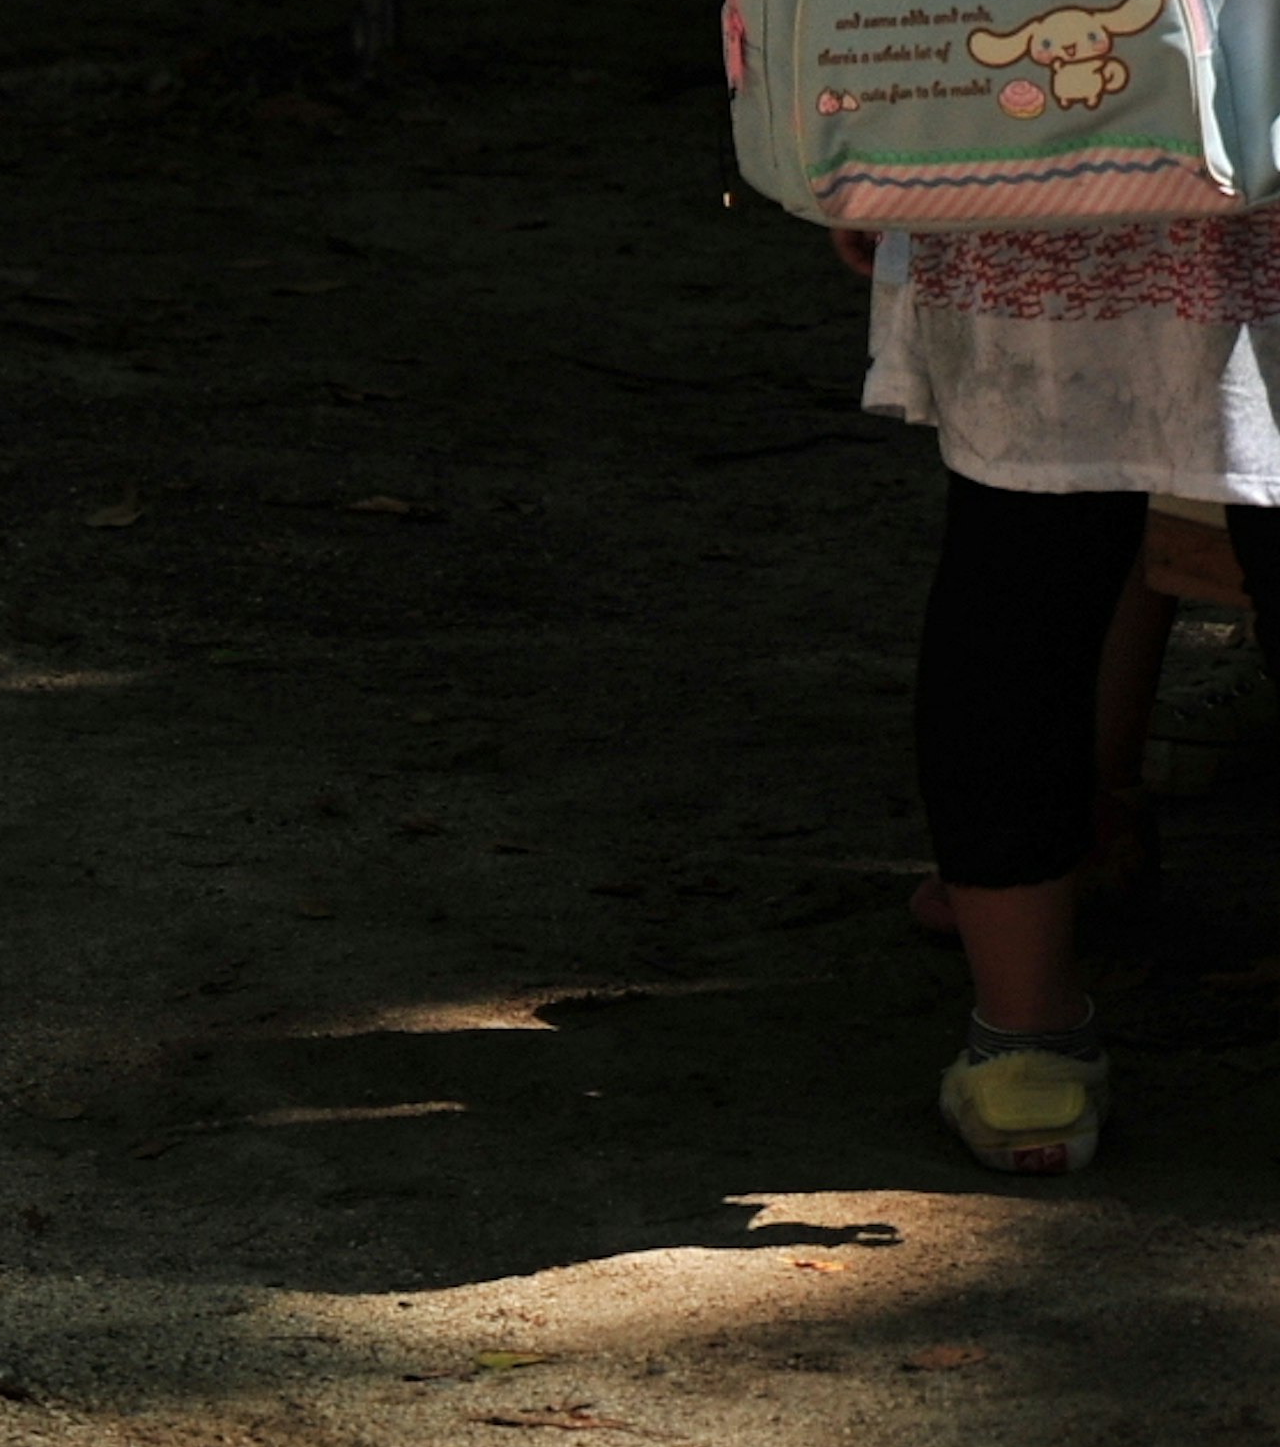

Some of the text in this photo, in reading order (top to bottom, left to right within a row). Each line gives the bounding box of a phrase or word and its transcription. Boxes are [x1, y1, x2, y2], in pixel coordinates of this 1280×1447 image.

[836, 13, 860, 29] and
[864, 15, 897, 28] some
[933, 8, 958, 24] and
[873, 45, 911, 62] whole
[915, 45, 931, 59] lot
[936, 42, 951, 63] of
[889, 84, 912, 104] fun
[917, 85, 928, 97] to
[932, 81, 947, 97] be
